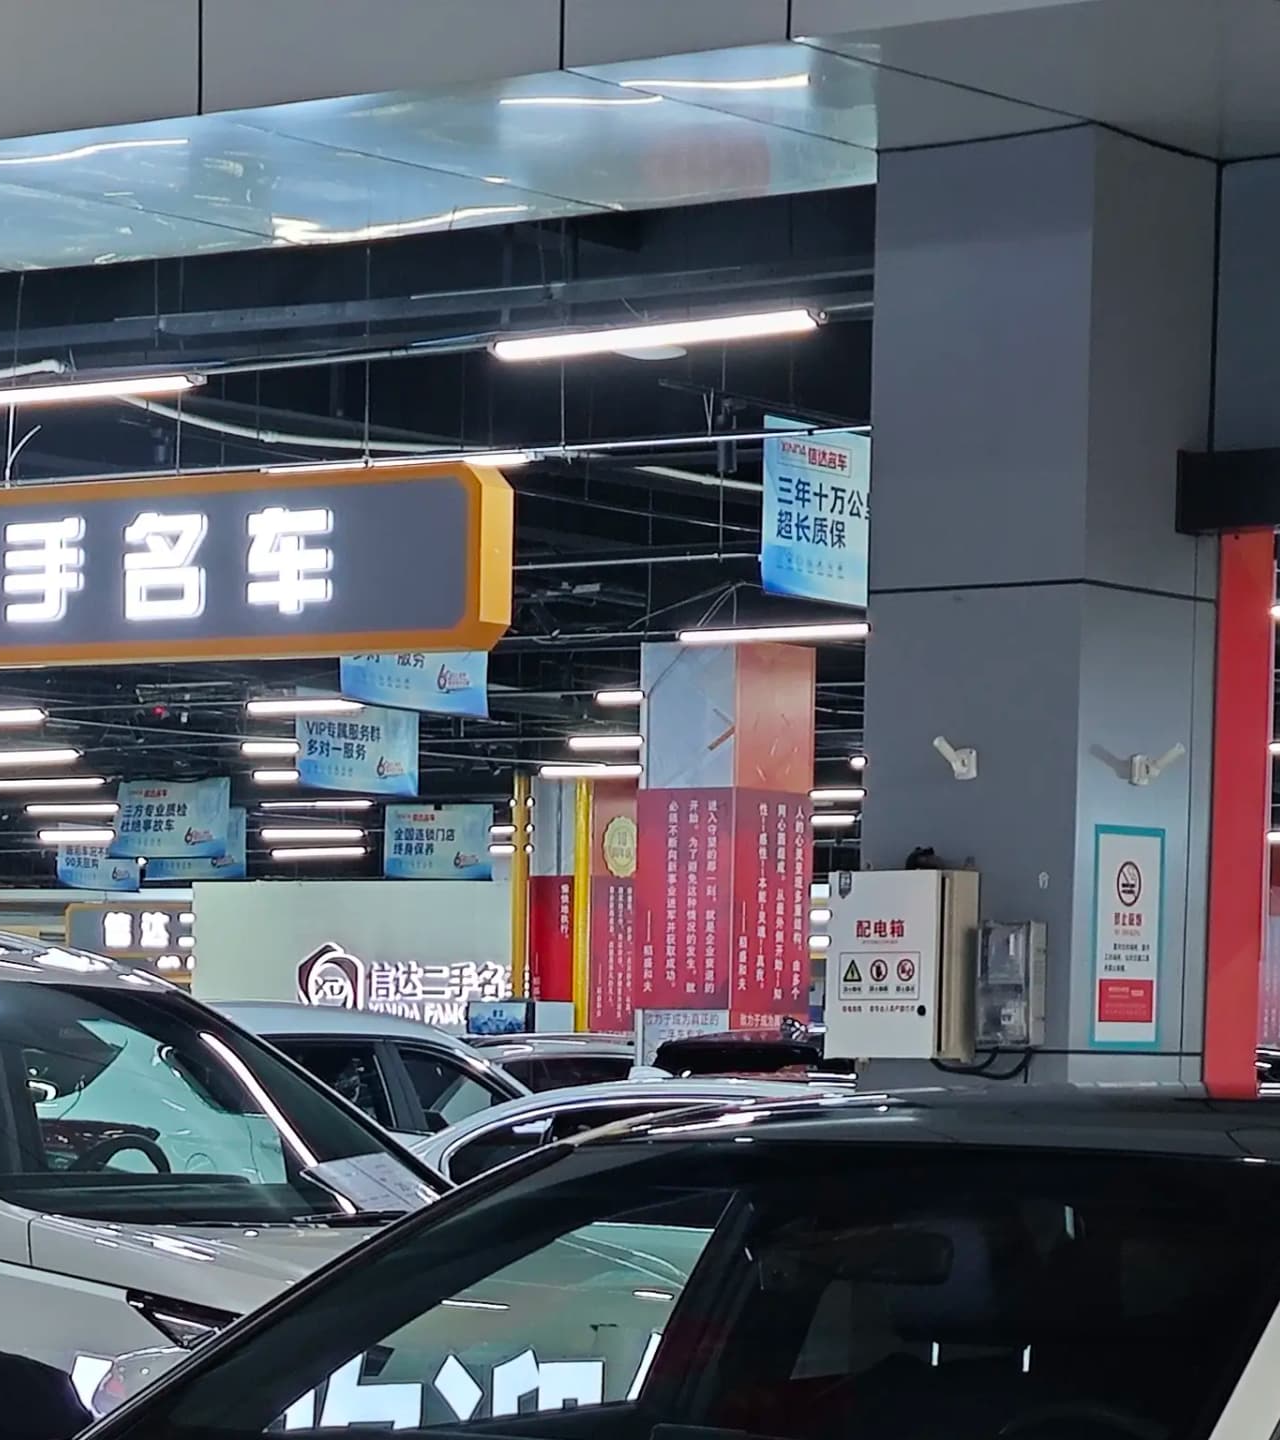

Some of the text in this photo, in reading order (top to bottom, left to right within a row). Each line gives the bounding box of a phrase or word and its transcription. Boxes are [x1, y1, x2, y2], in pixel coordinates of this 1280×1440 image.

[808, 448, 848, 472] 信达名车
[776, 509, 847, 549] 超长质保
[306, 720, 382, 743] VIP专属服务群
[307, 740, 367, 761] 多对一服务
[123, 802, 188, 819] 三方专业质检
[121, 819, 175, 834] 杜绝事故车
[394, 827, 456, 842] 全国连锁门店
[393, 842, 435, 856] 终身保养
[856, 919, 905, 939] 配电箱
[368, 961, 514, 1000] 信达二手名
